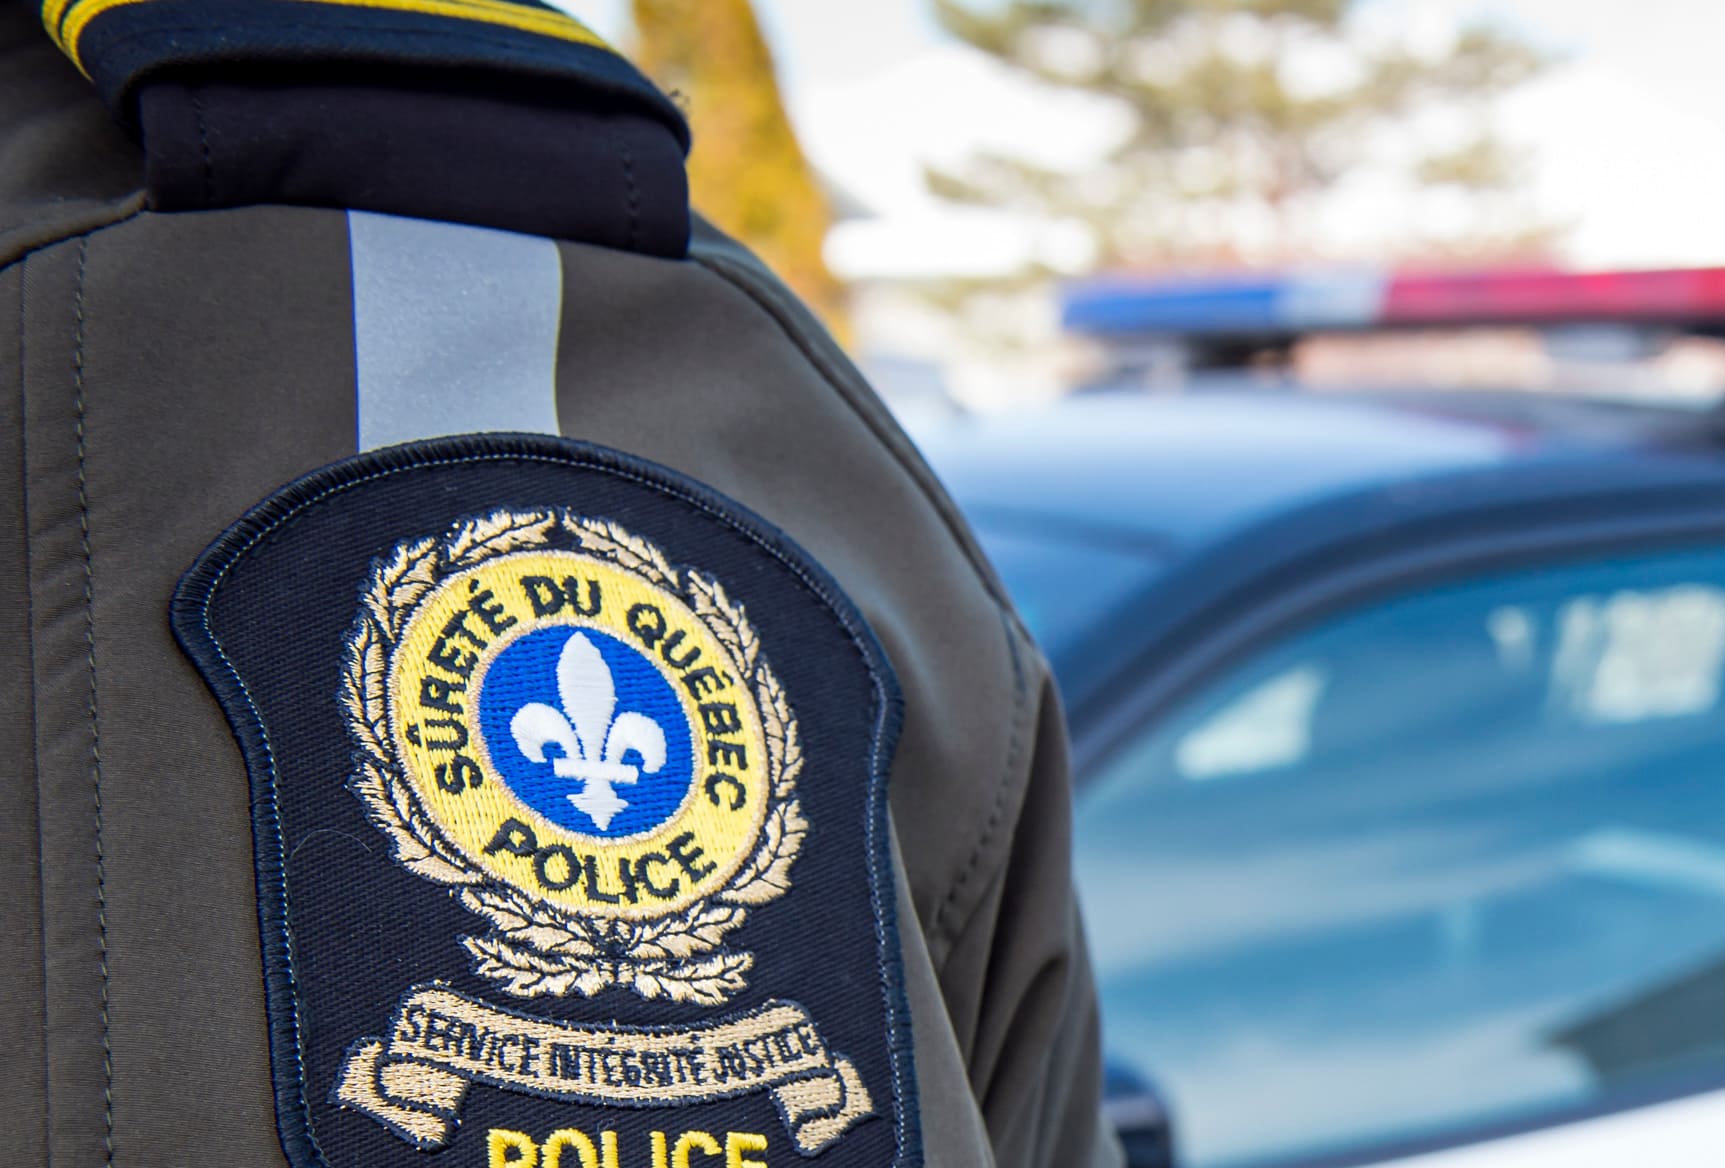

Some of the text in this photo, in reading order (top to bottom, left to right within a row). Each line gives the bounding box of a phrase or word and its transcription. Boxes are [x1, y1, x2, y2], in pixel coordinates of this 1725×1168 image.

[407, 575, 749, 811] SÛRETÉ DU QUÉBEC
[484, 818, 717, 904] POLICE
[400, 1004, 540, 1077] SERVICE
[713, 1022, 824, 1083] JUSTICE
